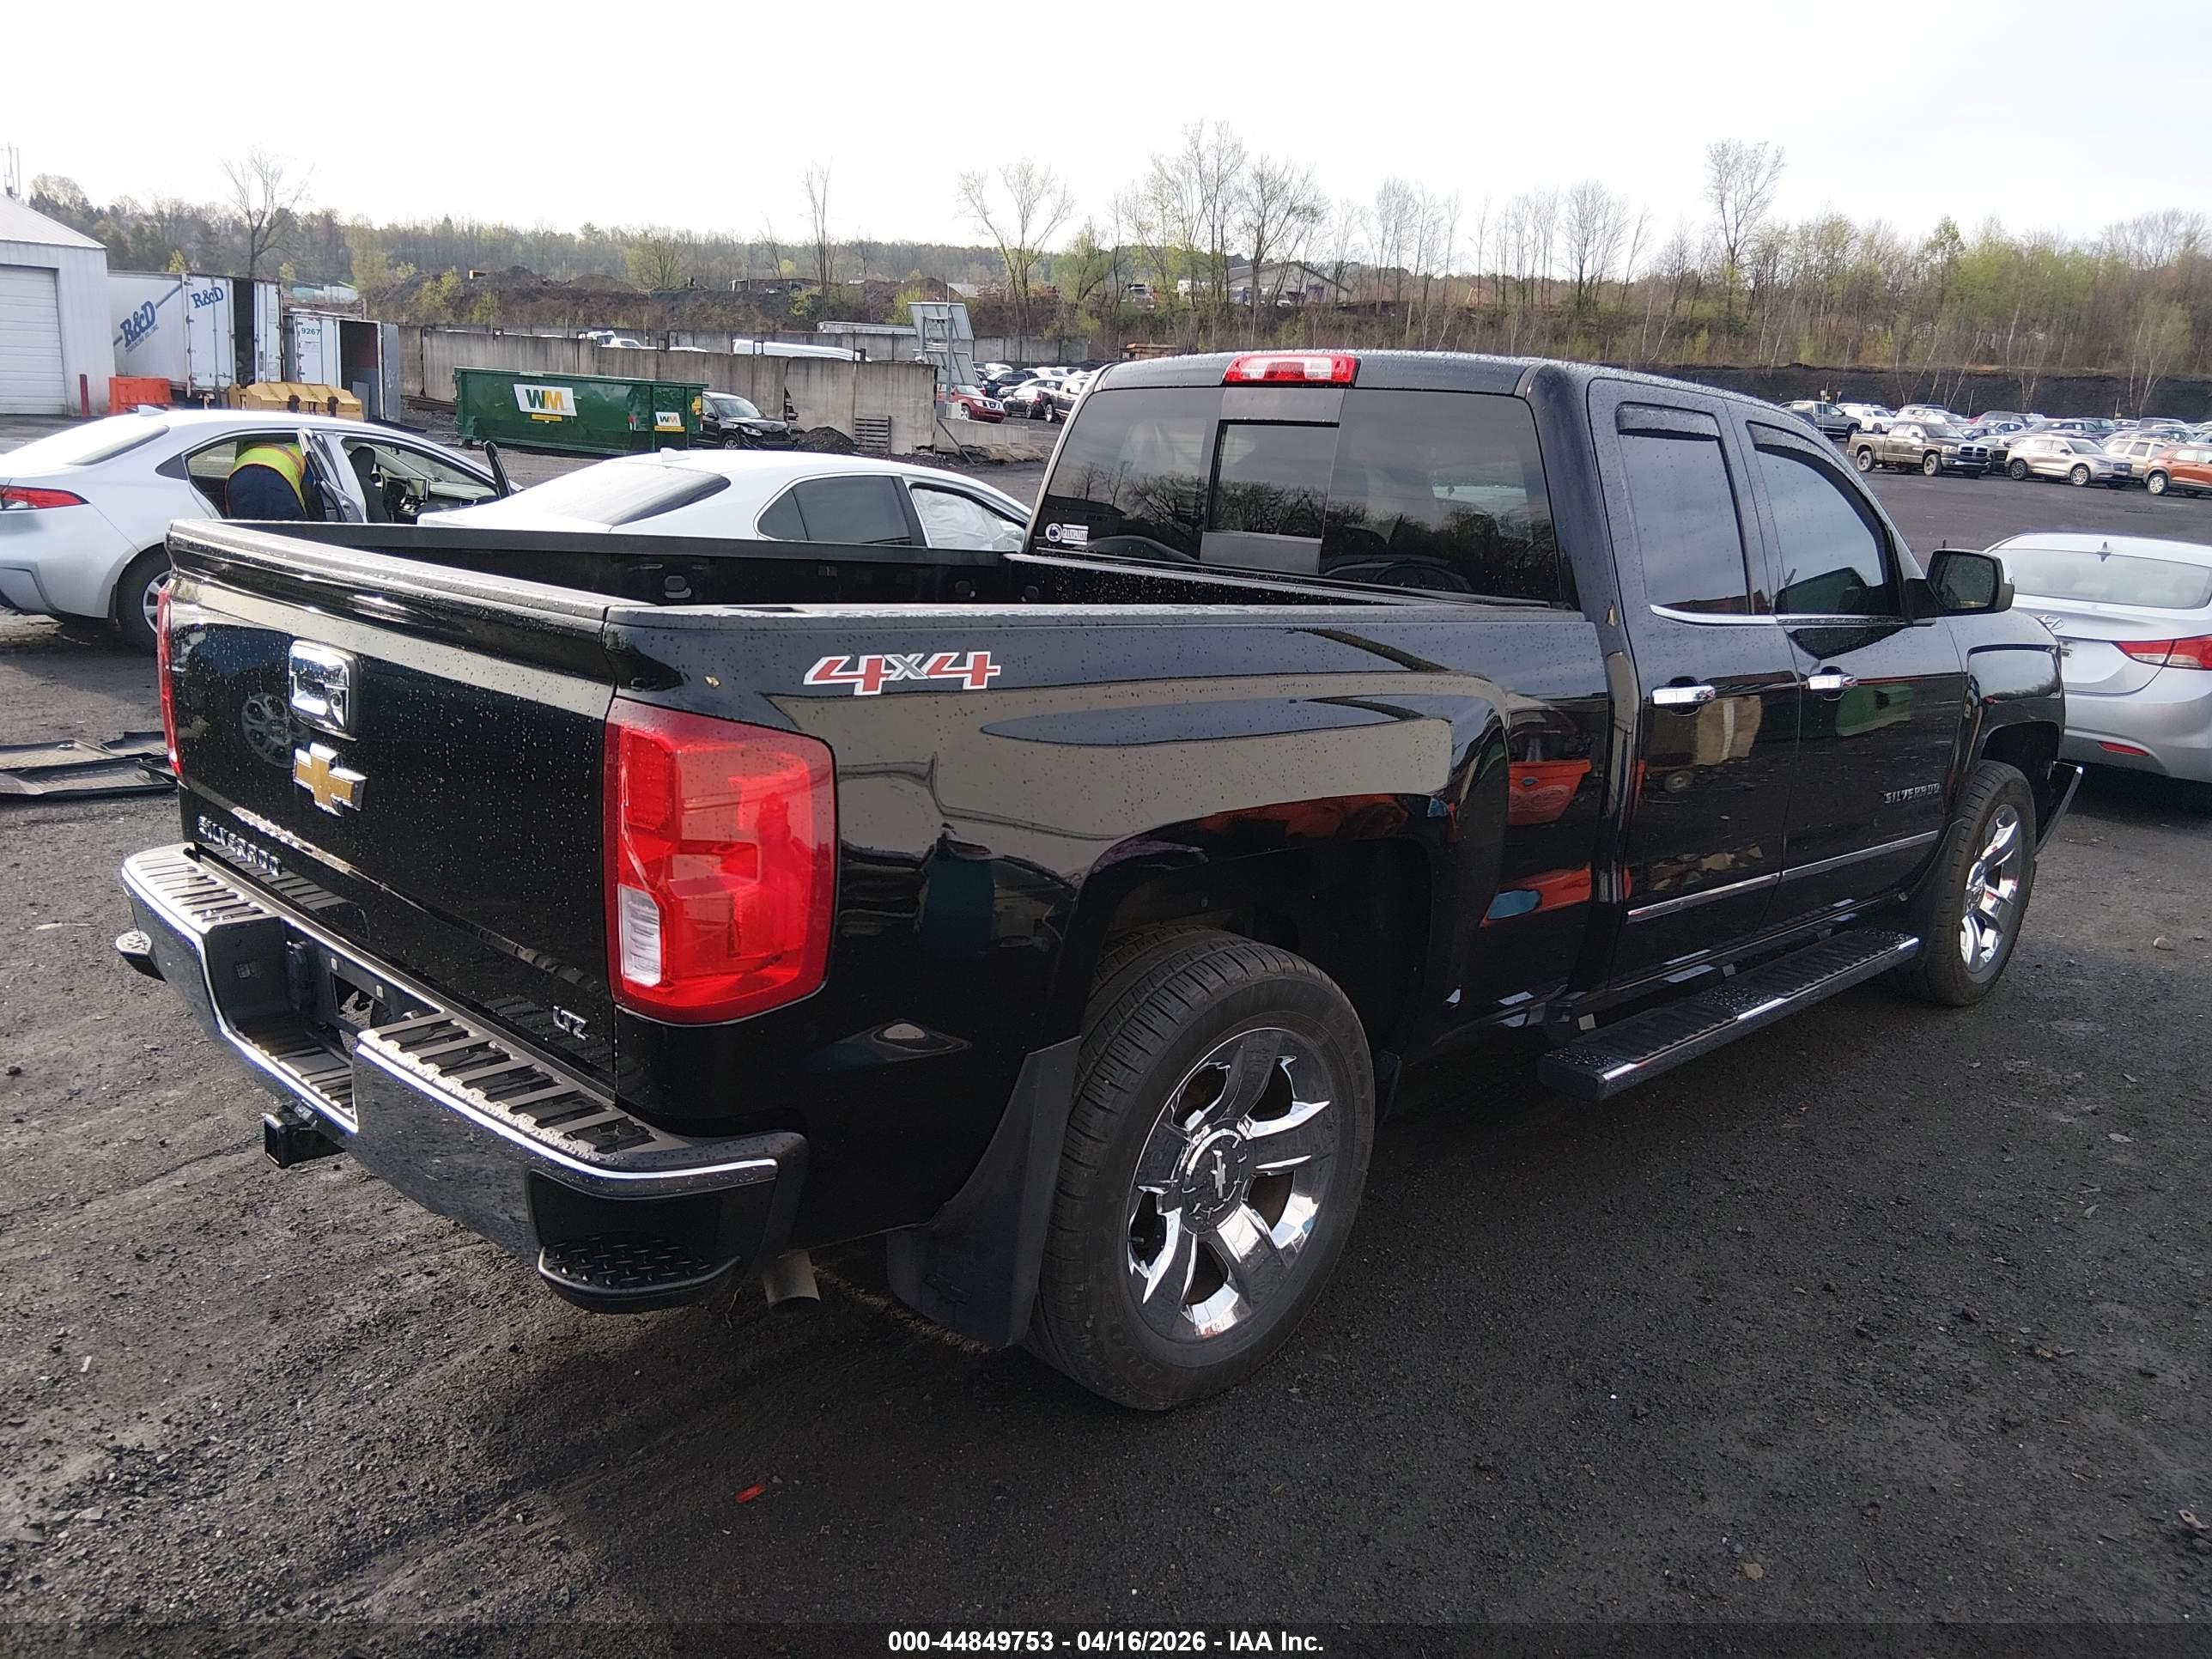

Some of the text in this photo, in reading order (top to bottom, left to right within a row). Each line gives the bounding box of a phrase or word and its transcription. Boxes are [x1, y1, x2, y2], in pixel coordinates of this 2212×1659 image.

[191, 287, 224, 309] R&D
[120, 301, 156, 348] R&D
[525, 388, 565, 410] WM
[659, 415, 678, 424] WM
[1884, 782, 1941, 804] SILVERADO
[552, 1005, 590, 1042] LTZ
